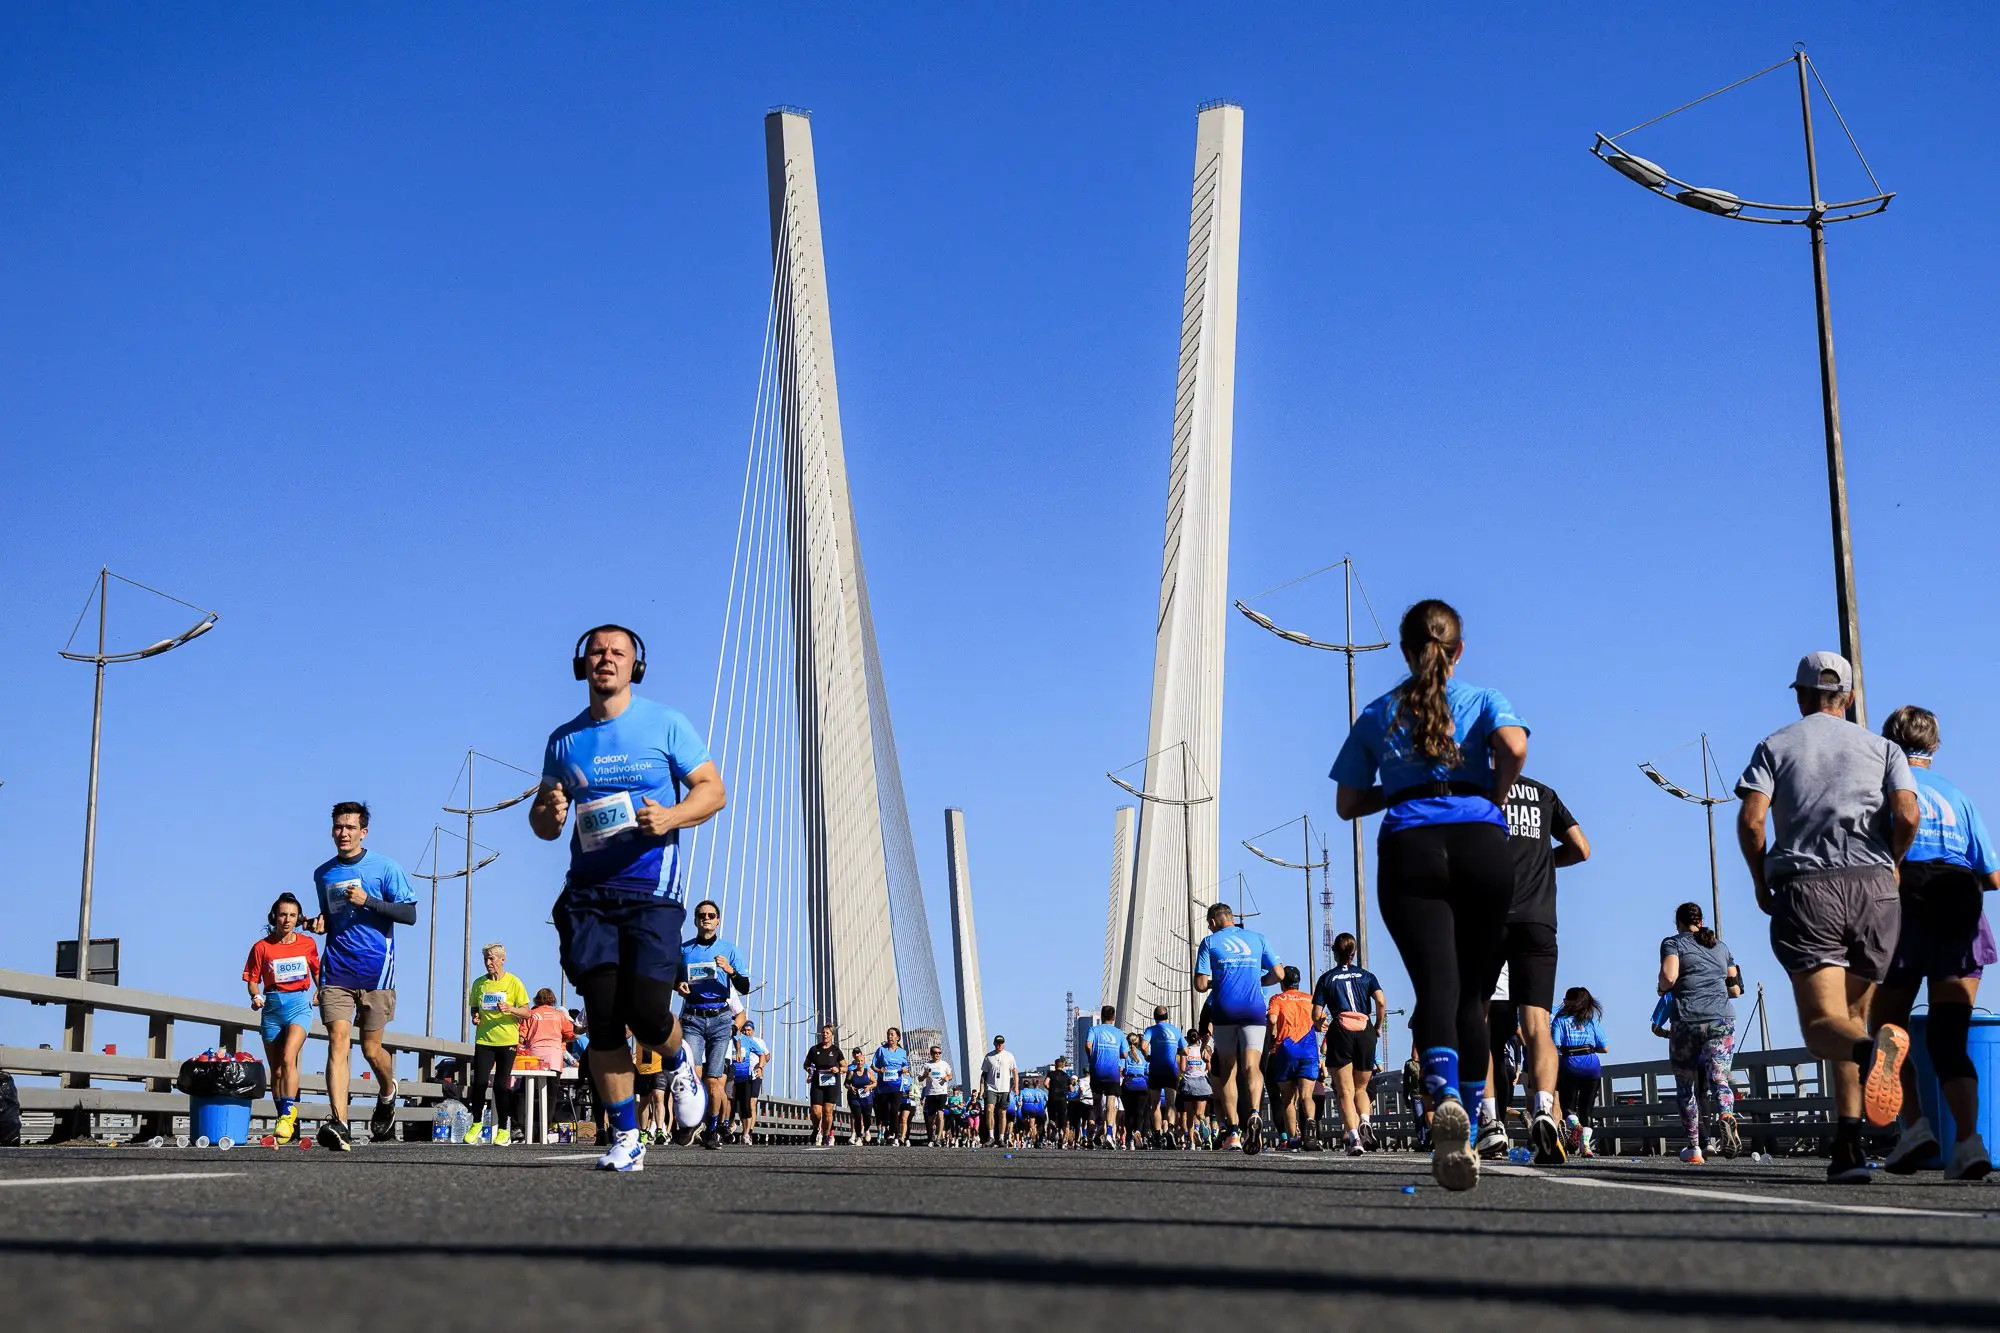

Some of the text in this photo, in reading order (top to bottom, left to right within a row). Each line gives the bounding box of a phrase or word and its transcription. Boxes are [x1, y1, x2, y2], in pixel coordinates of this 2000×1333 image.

[593, 754, 629, 764] Galaxy
[593, 761, 653, 776] Vladivostok
[594, 774, 643, 786] Marathon
[583, 808, 617, 830] 8187
[1520, 825, 1541, 840] CLUB
[279, 962, 302, 972] 8057
